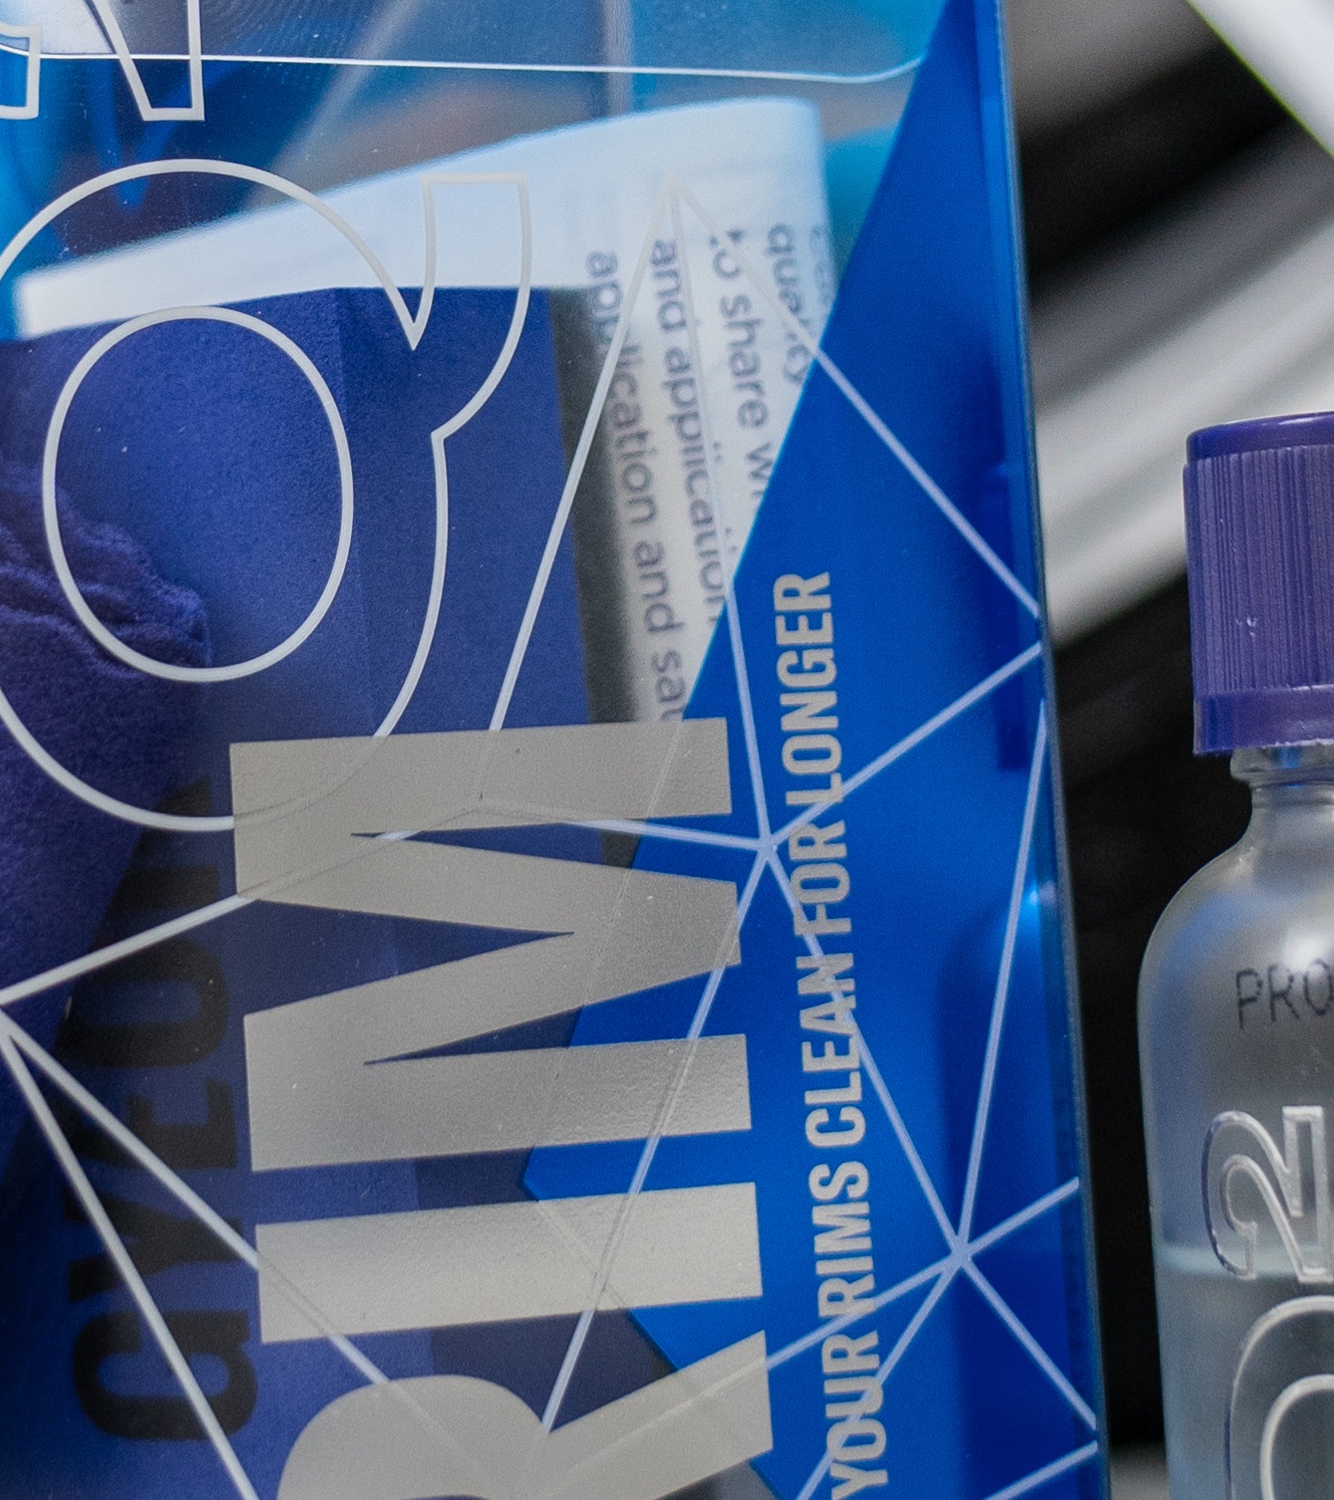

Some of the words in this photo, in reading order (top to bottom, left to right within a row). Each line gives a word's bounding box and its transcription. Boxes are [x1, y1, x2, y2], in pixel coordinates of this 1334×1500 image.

[720, 294, 770, 429] share
[634, 541, 687, 635] and
[773, 571, 844, 806] LONGER
[788, 820, 853, 937] FOR
[796, 952, 867, 1149] CLEAN
[808, 1161, 876, 1317] RIMS
